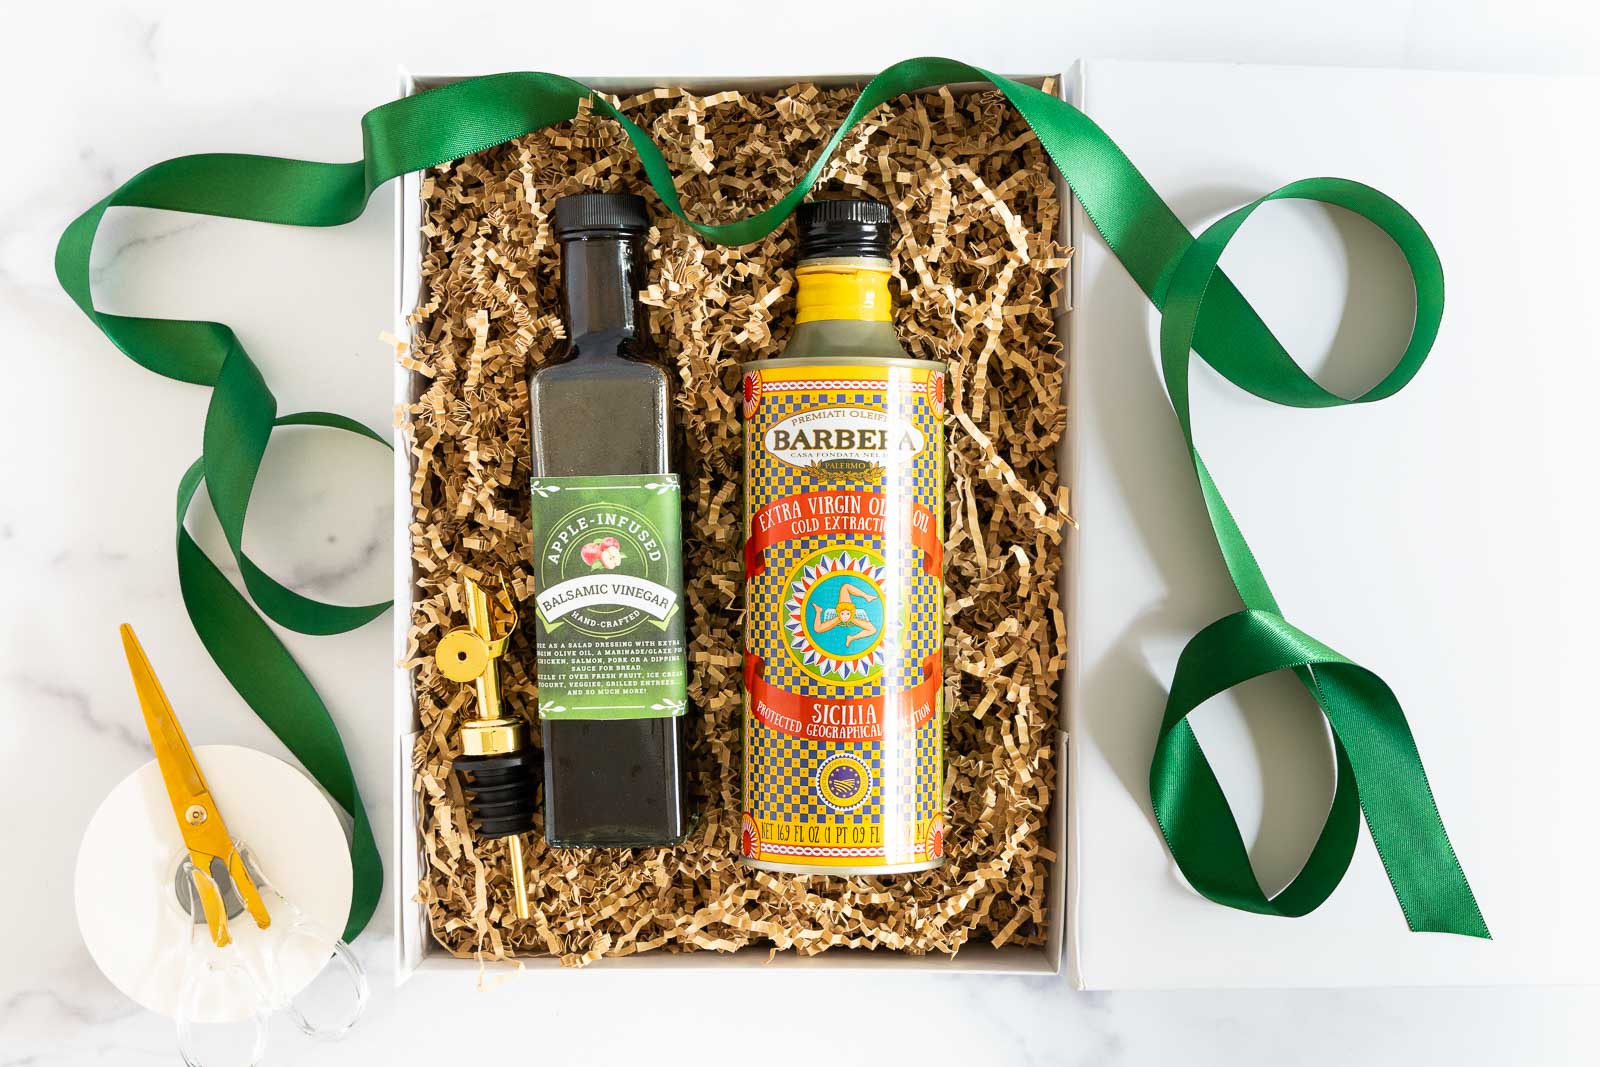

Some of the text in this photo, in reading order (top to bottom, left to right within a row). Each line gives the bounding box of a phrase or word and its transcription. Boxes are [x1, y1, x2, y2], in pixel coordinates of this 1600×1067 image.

[792, 409, 846, 426] PREMIATI
[825, 462, 866, 470] PALERMO
[758, 500, 802, 533] EXTRA
[808, 495, 862, 515] VIRGIN
[913, 510, 930, 533] OIL
[791, 516, 888, 535] COLD EXTRACTI
[548, 513, 662, 565] APPLE-INFUSED
[542, 584, 669, 612] BALSAMIC VINEGAR
[571, 610, 641, 628] HAND-CRAFTED
[756, 700, 803, 733] PROTECTED
[806, 723, 883, 739] GEOGRAPHICAL
[812, 703, 877, 725] SICILIA
[761, 822, 775, 841] NET
[794, 826, 805, 843] FL
[808, 827, 820, 843] OZ
[836, 827, 848, 844] PT
[870, 826, 880, 843] FL
